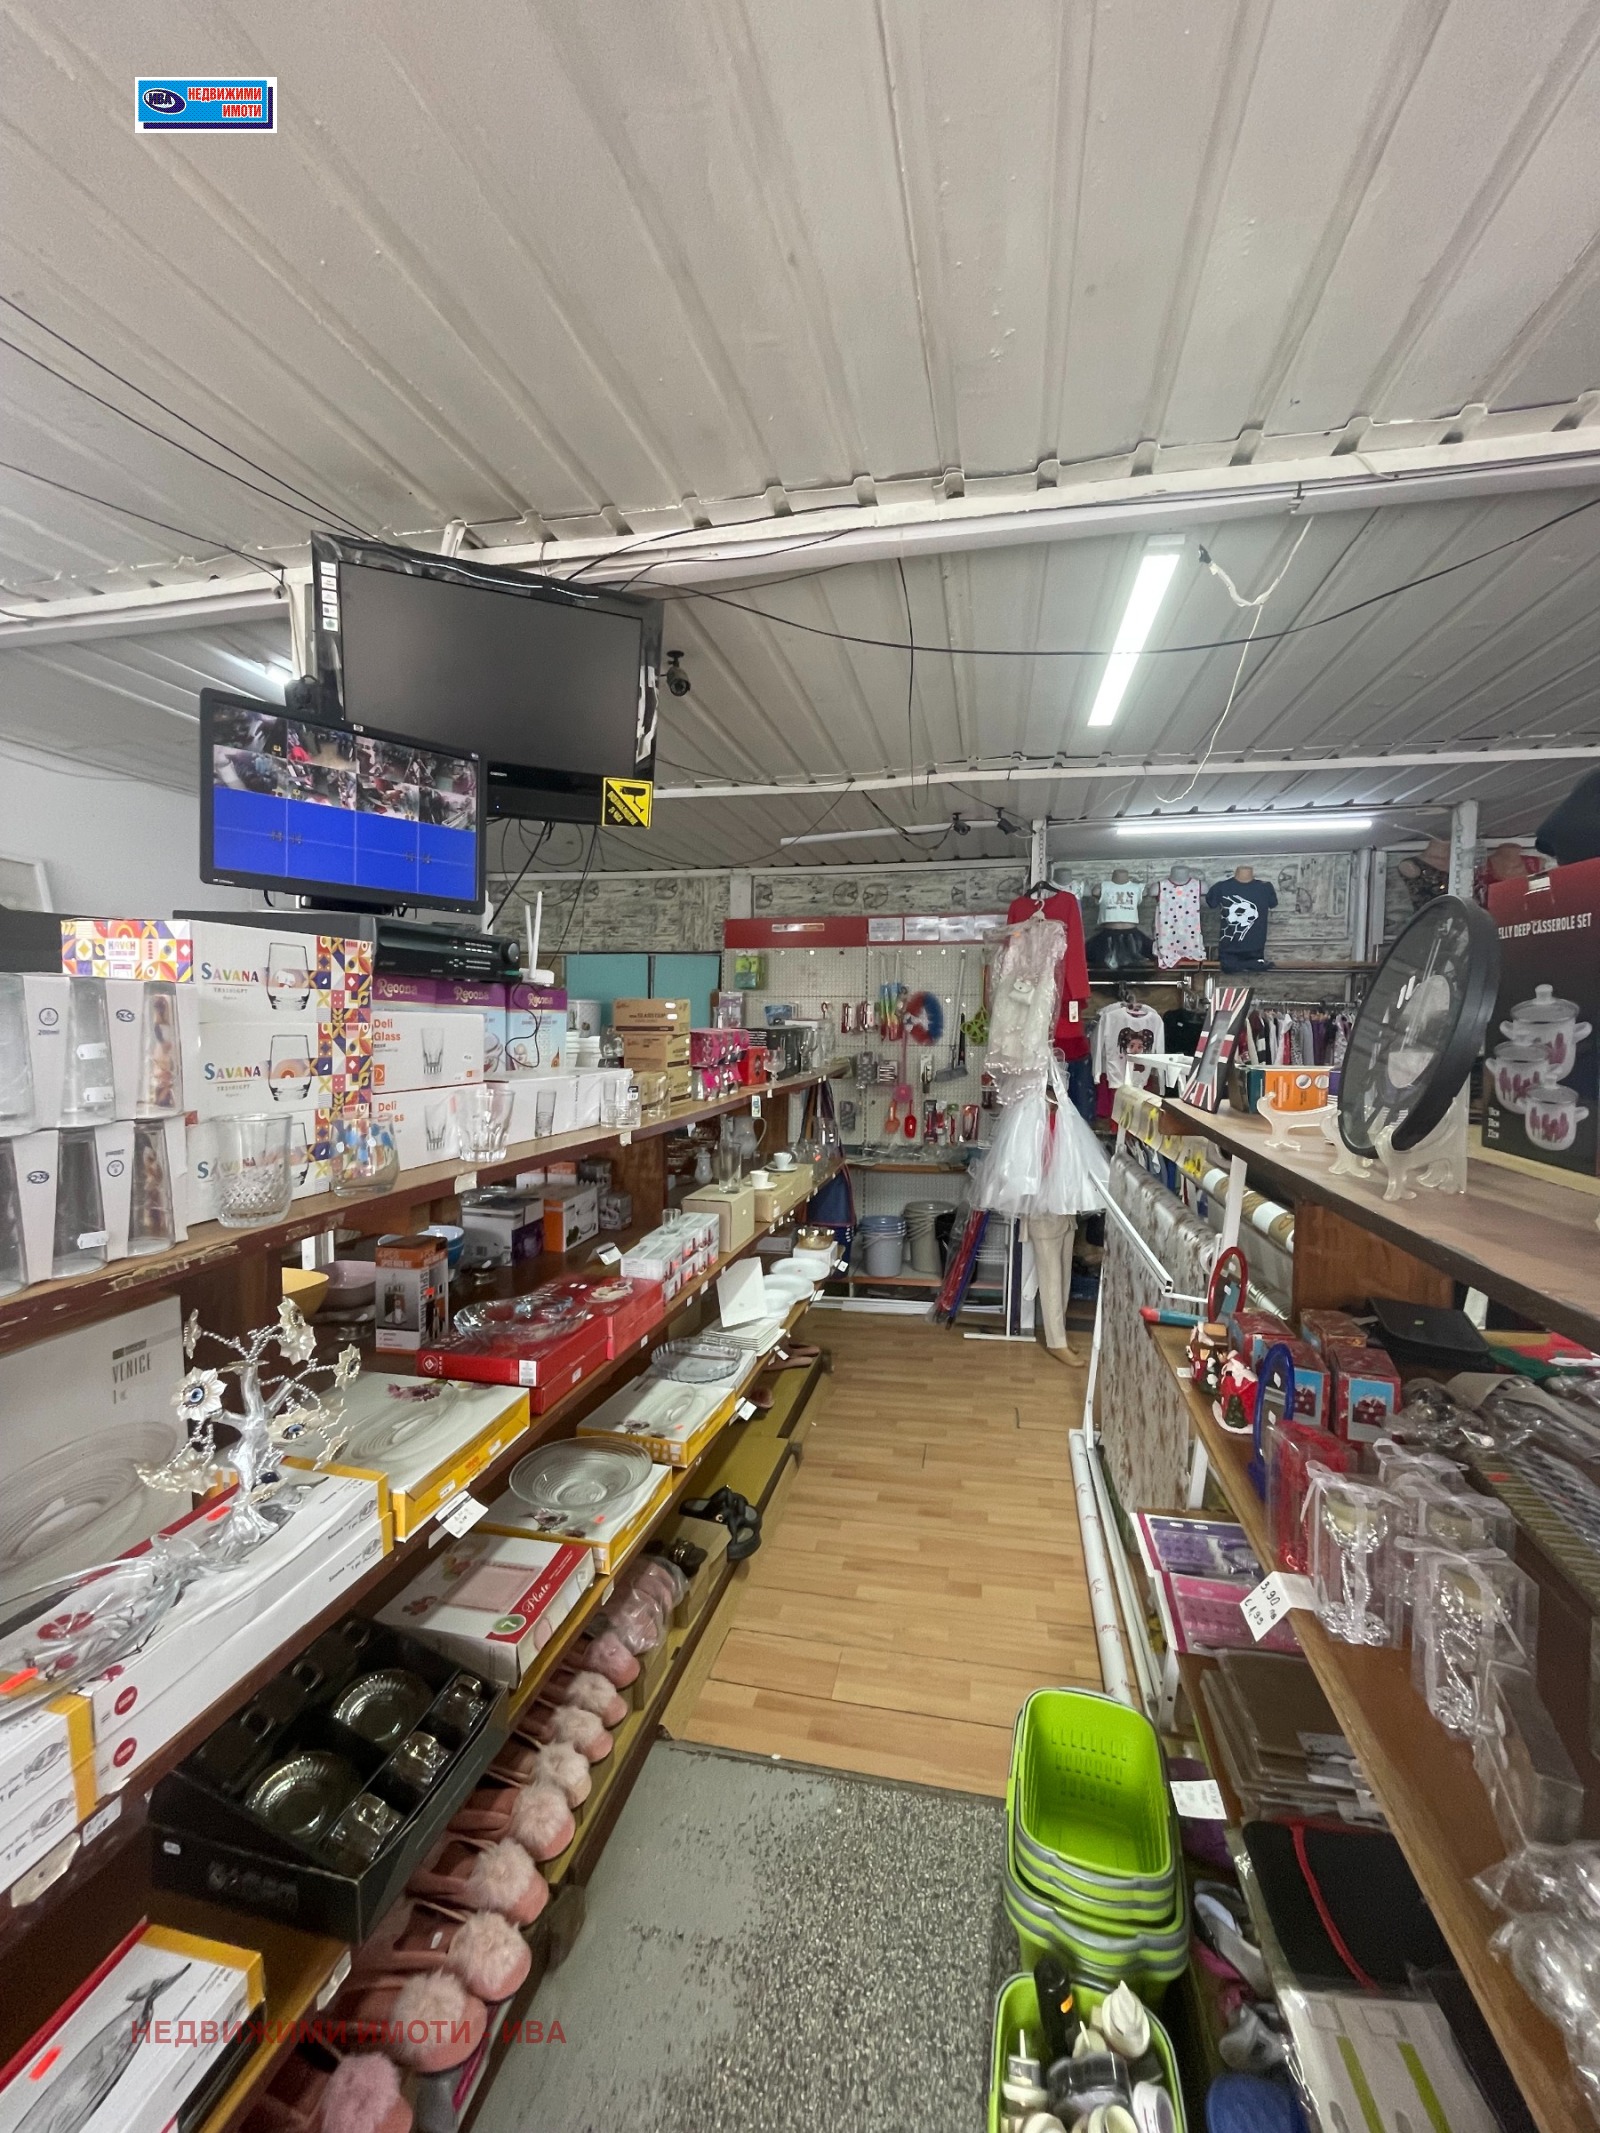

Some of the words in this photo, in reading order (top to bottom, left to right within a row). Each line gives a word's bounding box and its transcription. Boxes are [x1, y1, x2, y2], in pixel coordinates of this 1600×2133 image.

[1514, 922, 1532, 938] DEEP
[1532, 915, 1575, 935] CASSEROLE
[1576, 911, 1593, 929] SET
[201, 962, 259, 983] SAVANA
[374, 1019, 393, 1028] Deli
[374, 1032, 401, 1041] Glass
[204, 1062, 261, 1081] SAVANA
[378, 1101, 397, 1112] Deli
[112, 1351, 152, 1384] VENICE
[521, 1583, 552, 1613] Plate
[1260, 1581, 1281, 1606] 3,90
